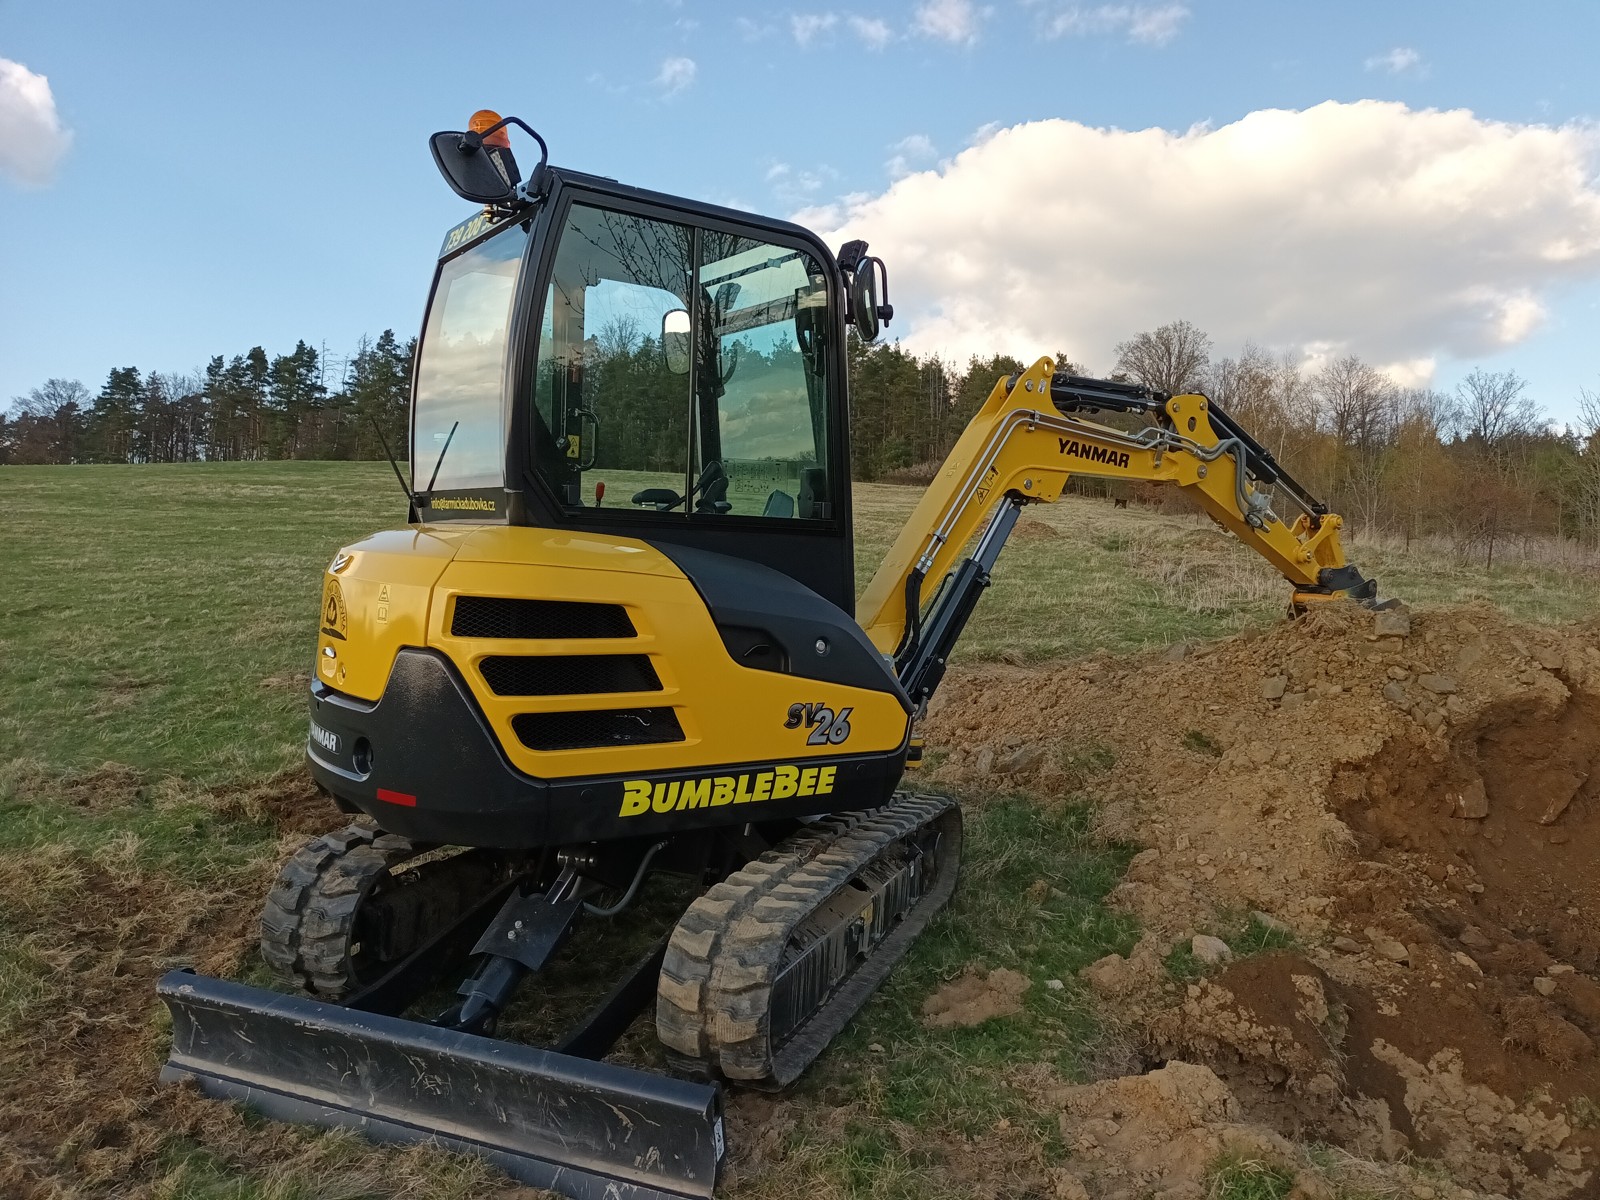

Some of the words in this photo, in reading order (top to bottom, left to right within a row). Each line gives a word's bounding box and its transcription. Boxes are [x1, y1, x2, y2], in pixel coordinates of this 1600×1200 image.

[1058, 437, 1130, 469] YANMAR
[783, 702, 854, 746] SV26
[619, 765, 837, 817] BUMBLEBEE
